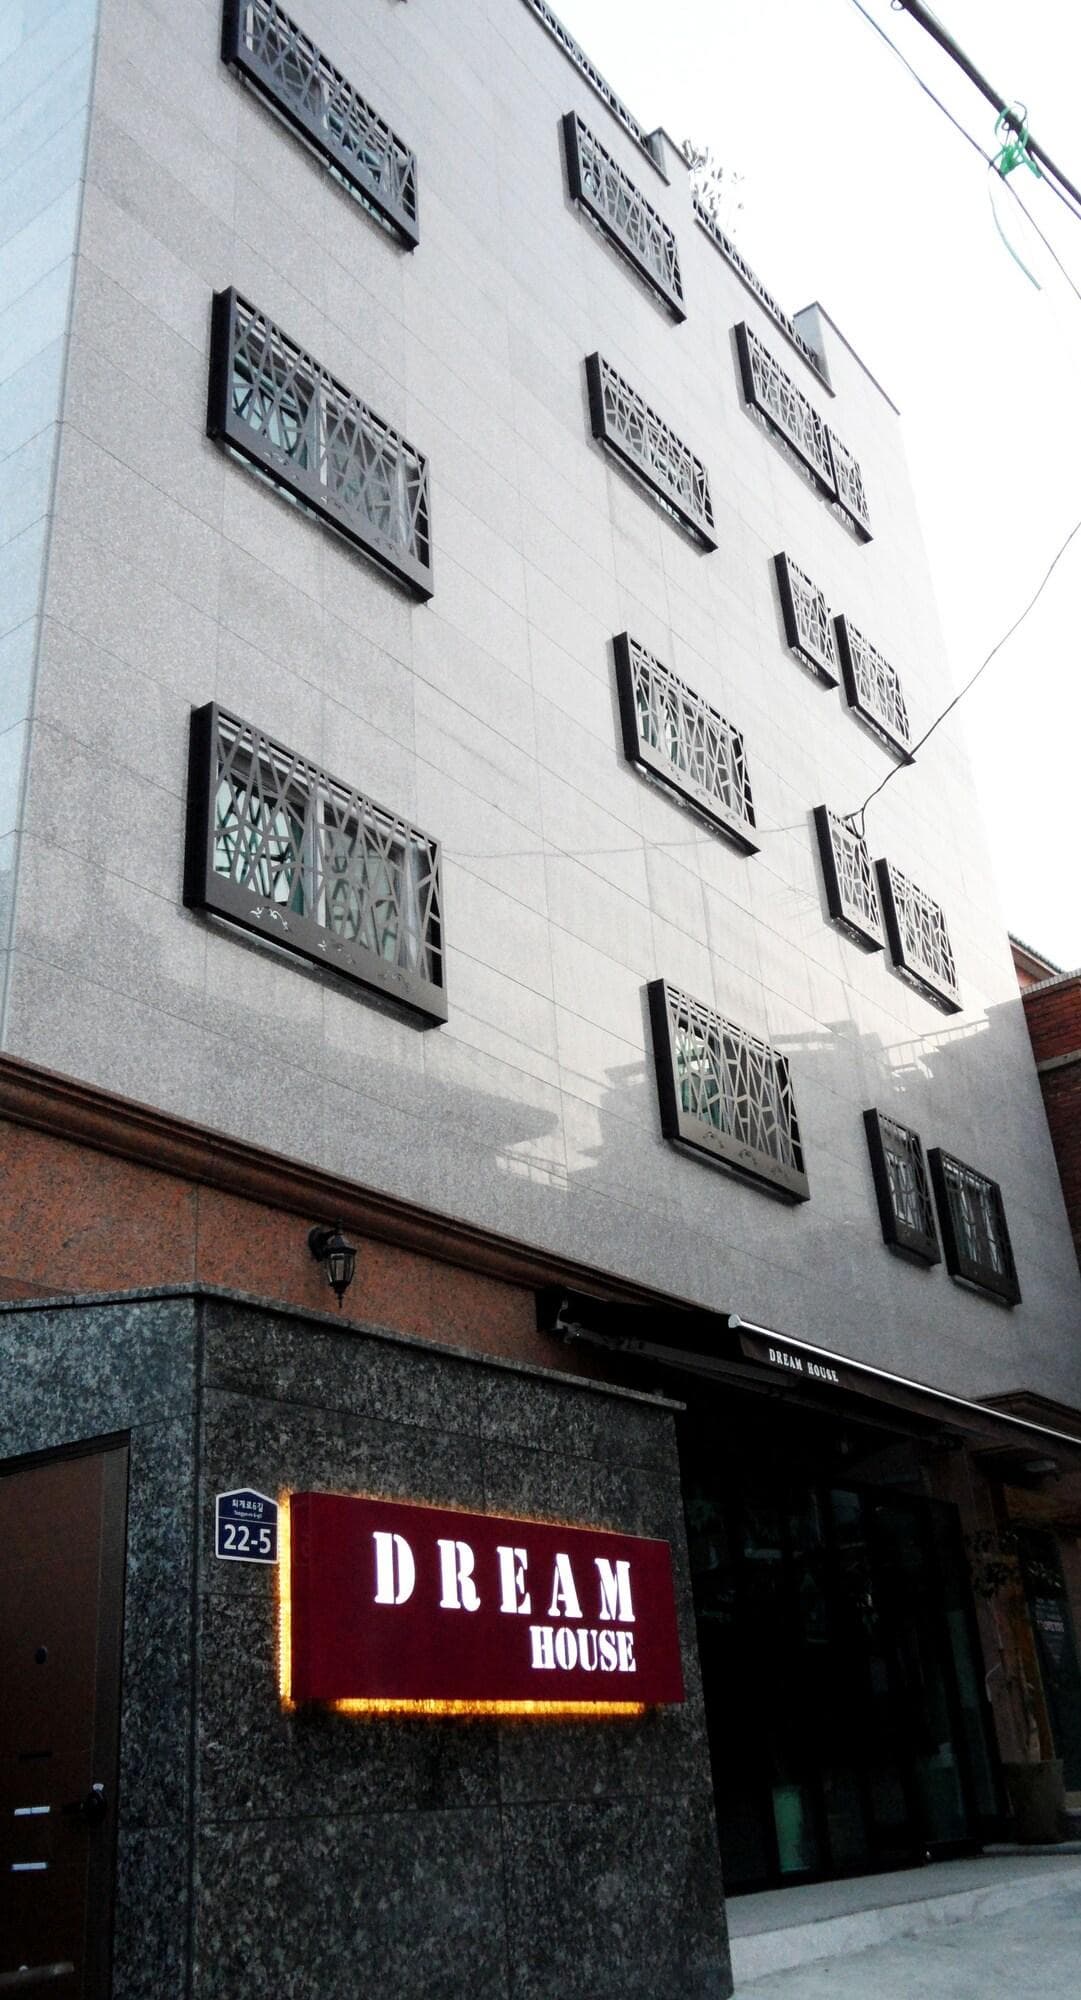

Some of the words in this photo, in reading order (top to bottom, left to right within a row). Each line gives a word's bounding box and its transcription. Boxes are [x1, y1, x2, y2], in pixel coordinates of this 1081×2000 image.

[769, 1348, 803, 1371] DREAM
[807, 1361, 839, 1383] HOUSE
[224, 1523, 272, 1554] 22-5
[373, 1531, 636, 1622] DREAM
[529, 1625, 637, 1672] HOUSE
